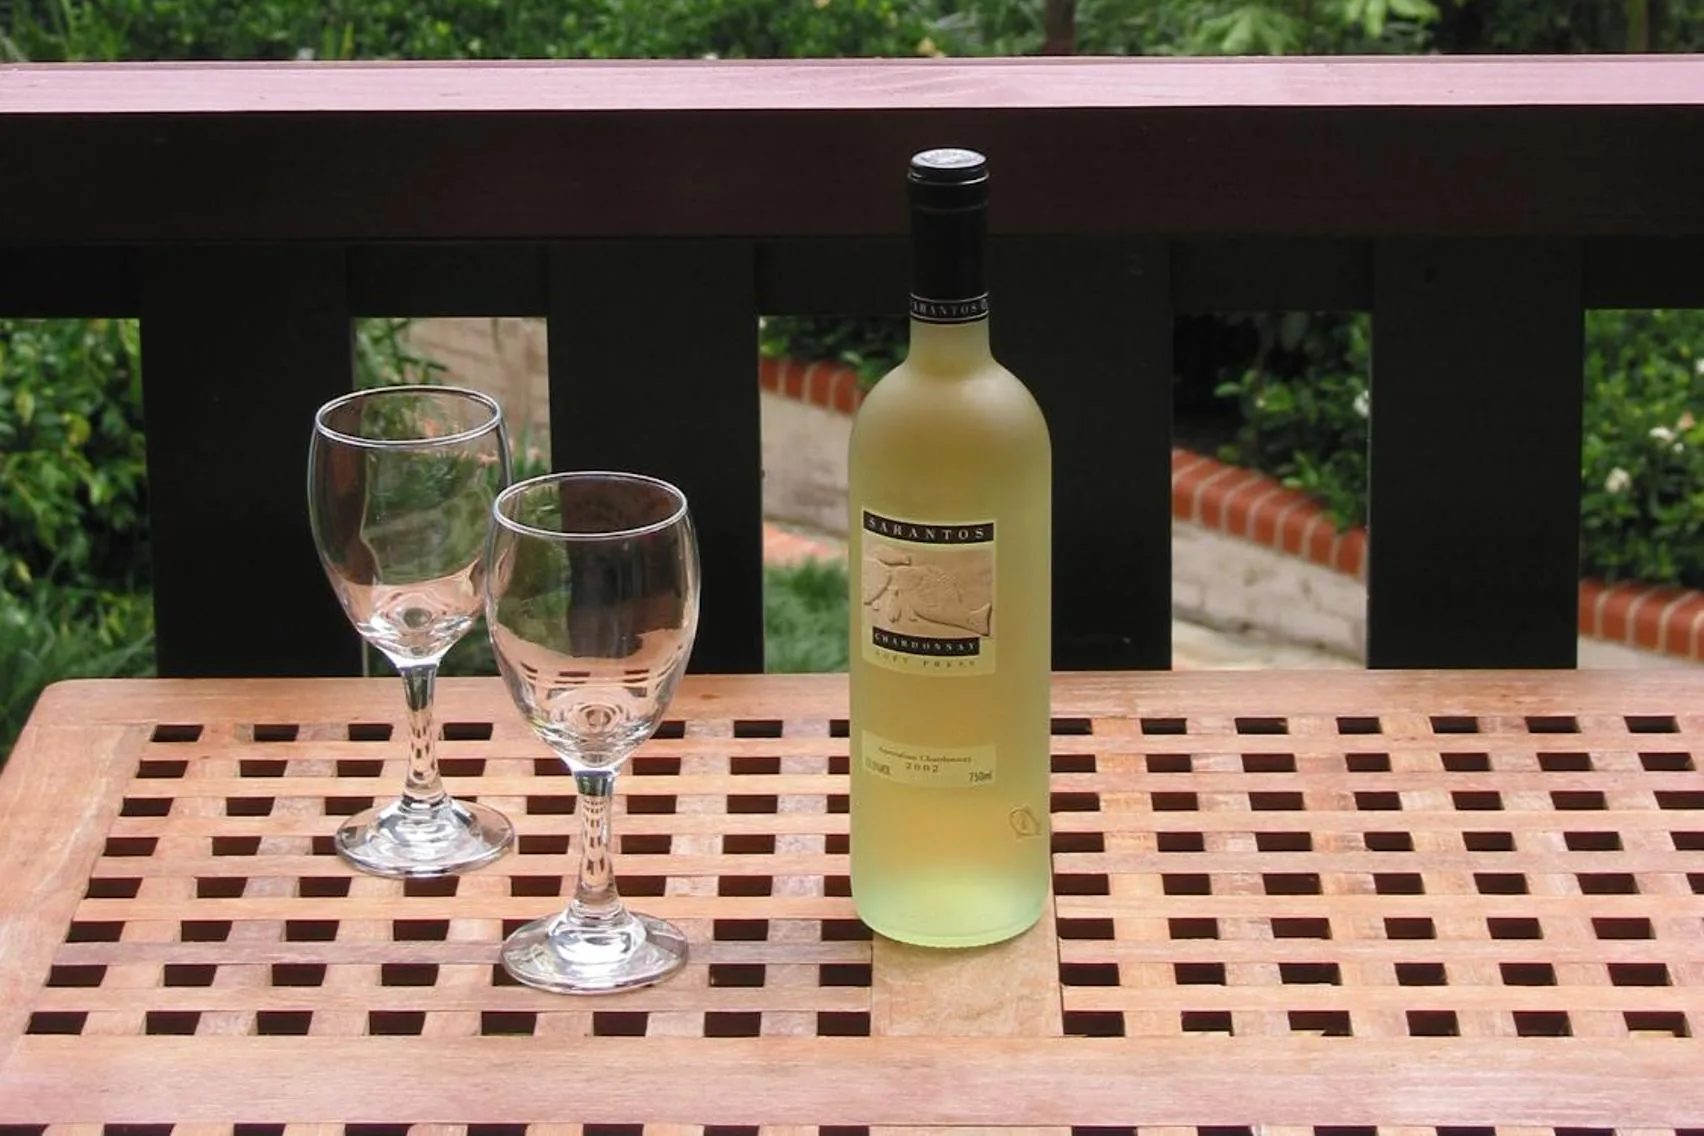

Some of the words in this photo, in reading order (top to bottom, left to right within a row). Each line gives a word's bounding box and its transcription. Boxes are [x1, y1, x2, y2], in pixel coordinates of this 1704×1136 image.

[911, 300, 978, 316] ARANTOS
[867, 517, 985, 540] SARANTOS
[874, 632, 976, 651] CHARDONNAY
[905, 762, 939, 773] 2002
[968, 770, 993, 783] 750ml
